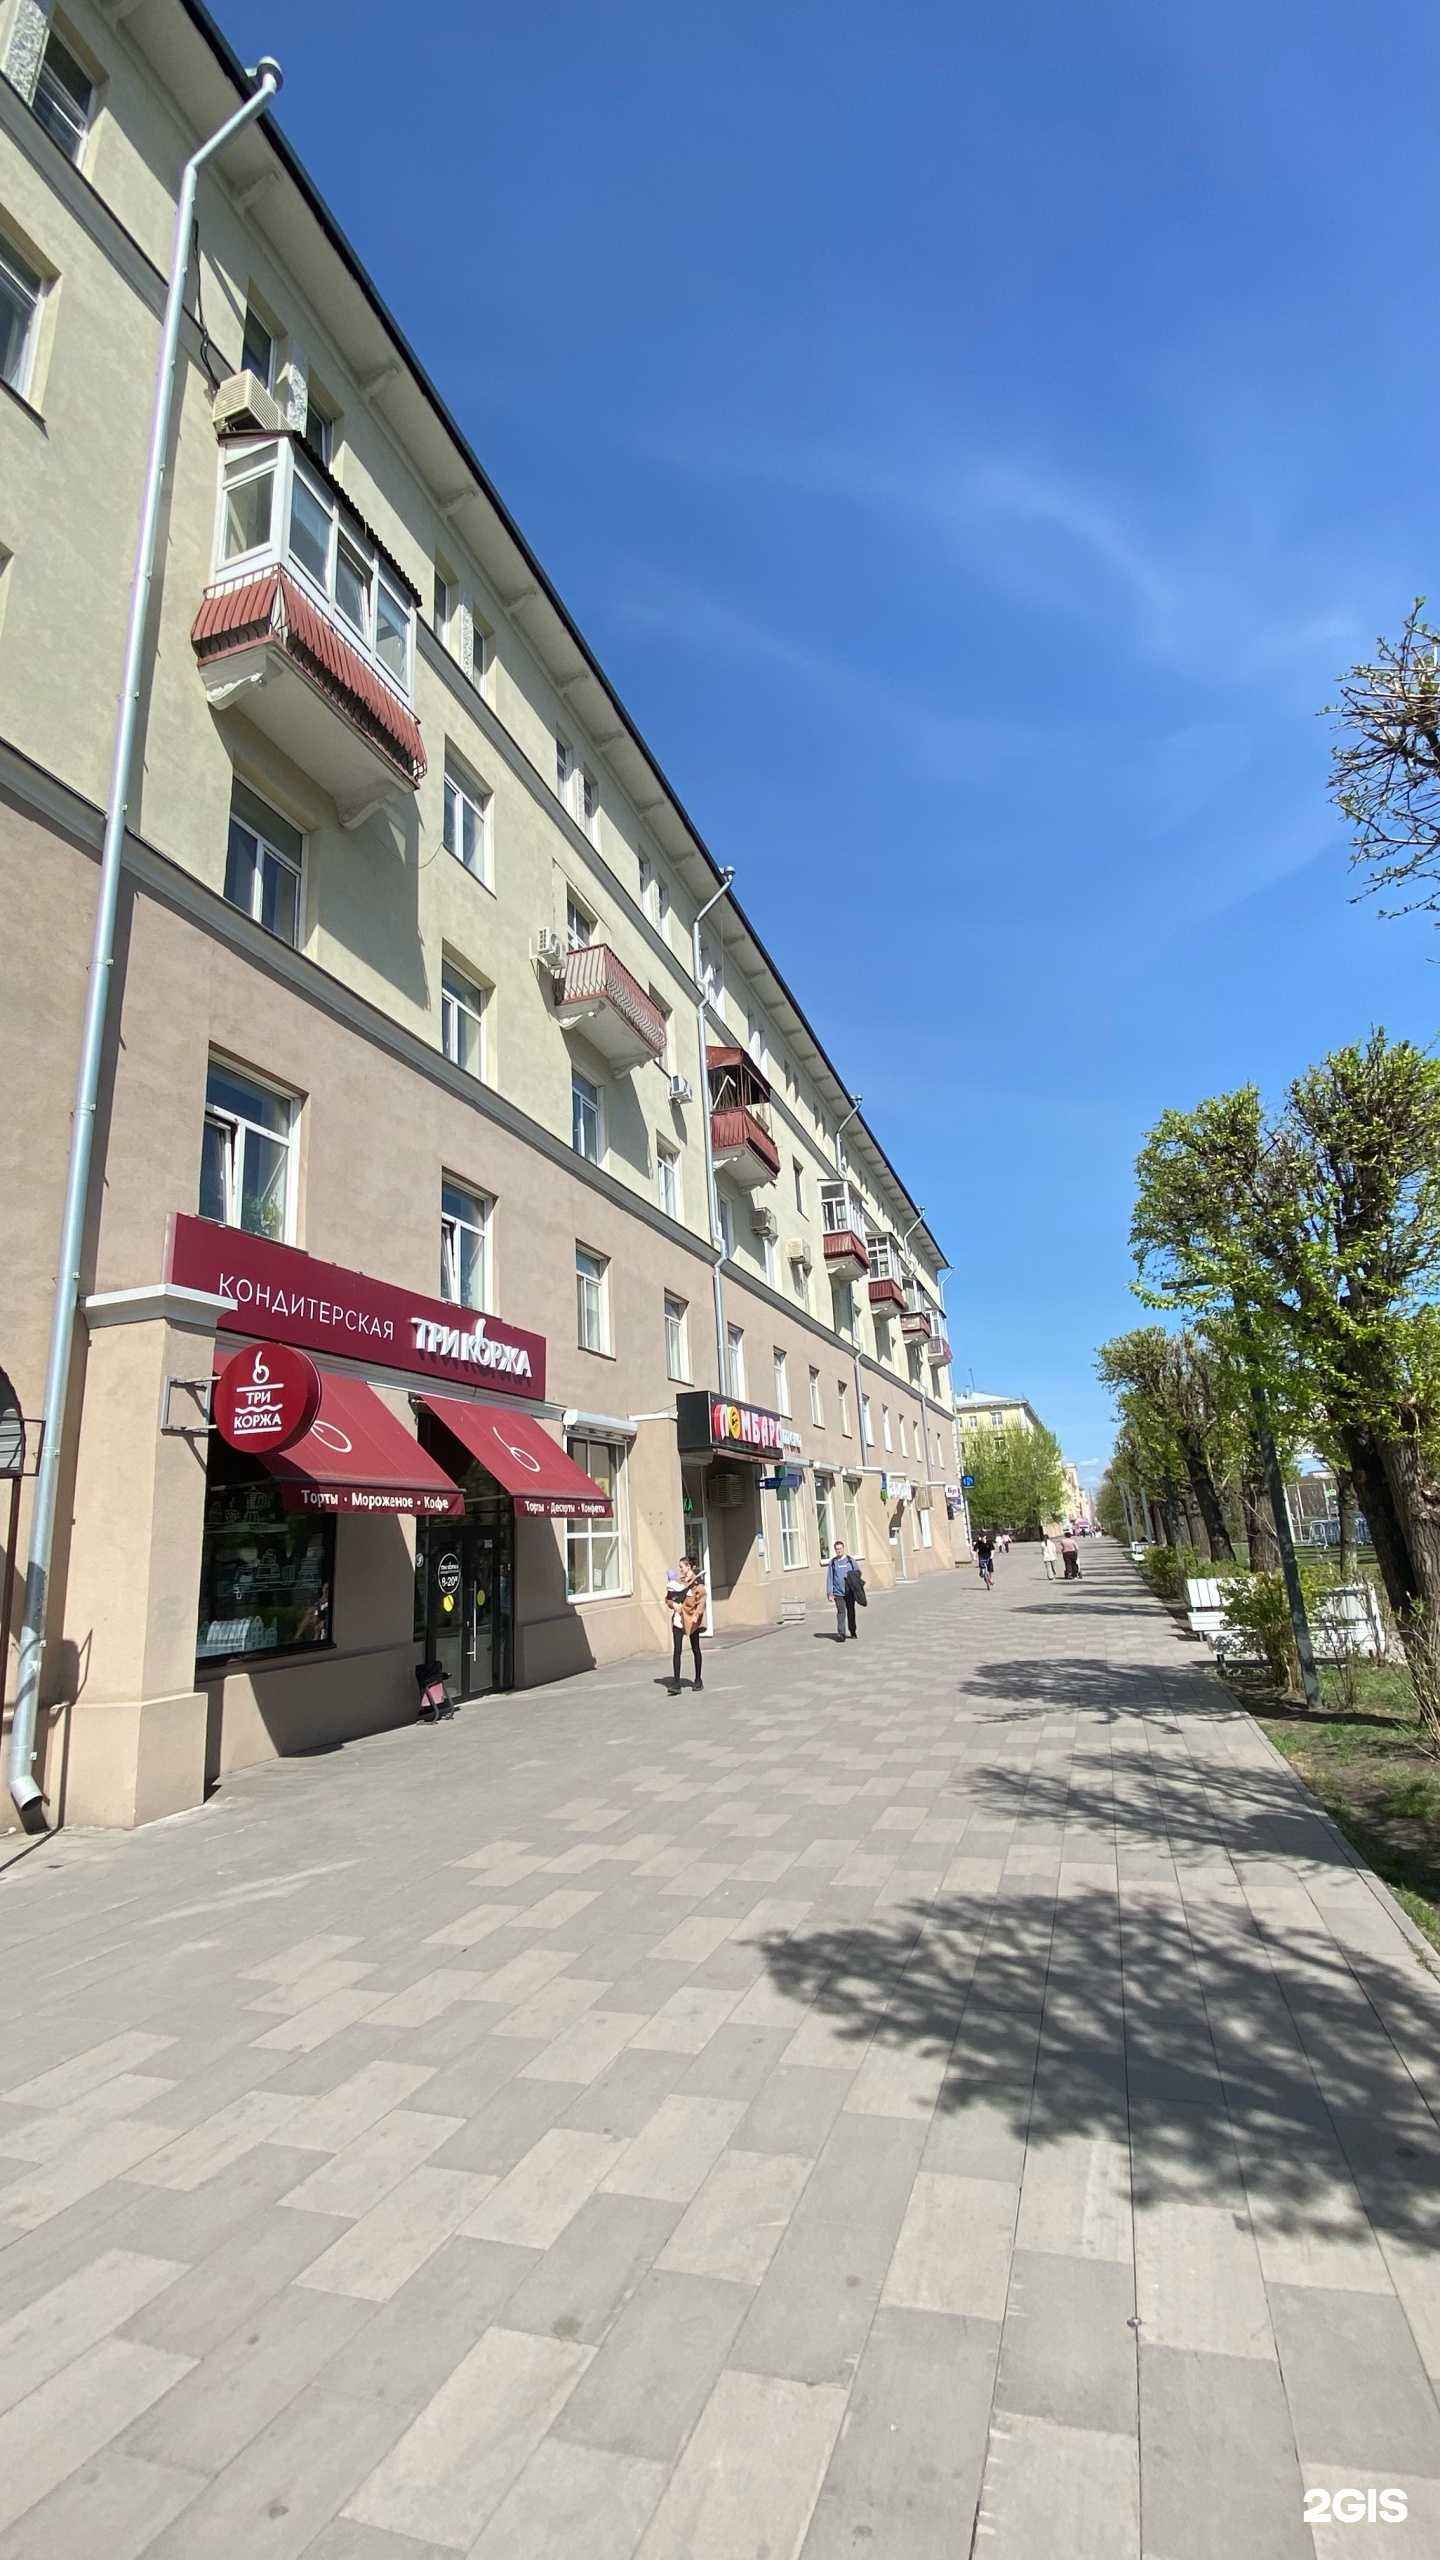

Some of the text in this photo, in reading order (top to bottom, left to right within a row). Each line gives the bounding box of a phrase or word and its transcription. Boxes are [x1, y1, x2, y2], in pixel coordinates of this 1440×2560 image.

[219, 1273, 394, 1341] КОНДИТЕРСКАЯ
[246, 1391, 271, 1404] ТРИ
[233, 1413, 282, 1429] КОРЖА
[301, 1489, 449, 1511] Торты Мороженое Кофе
